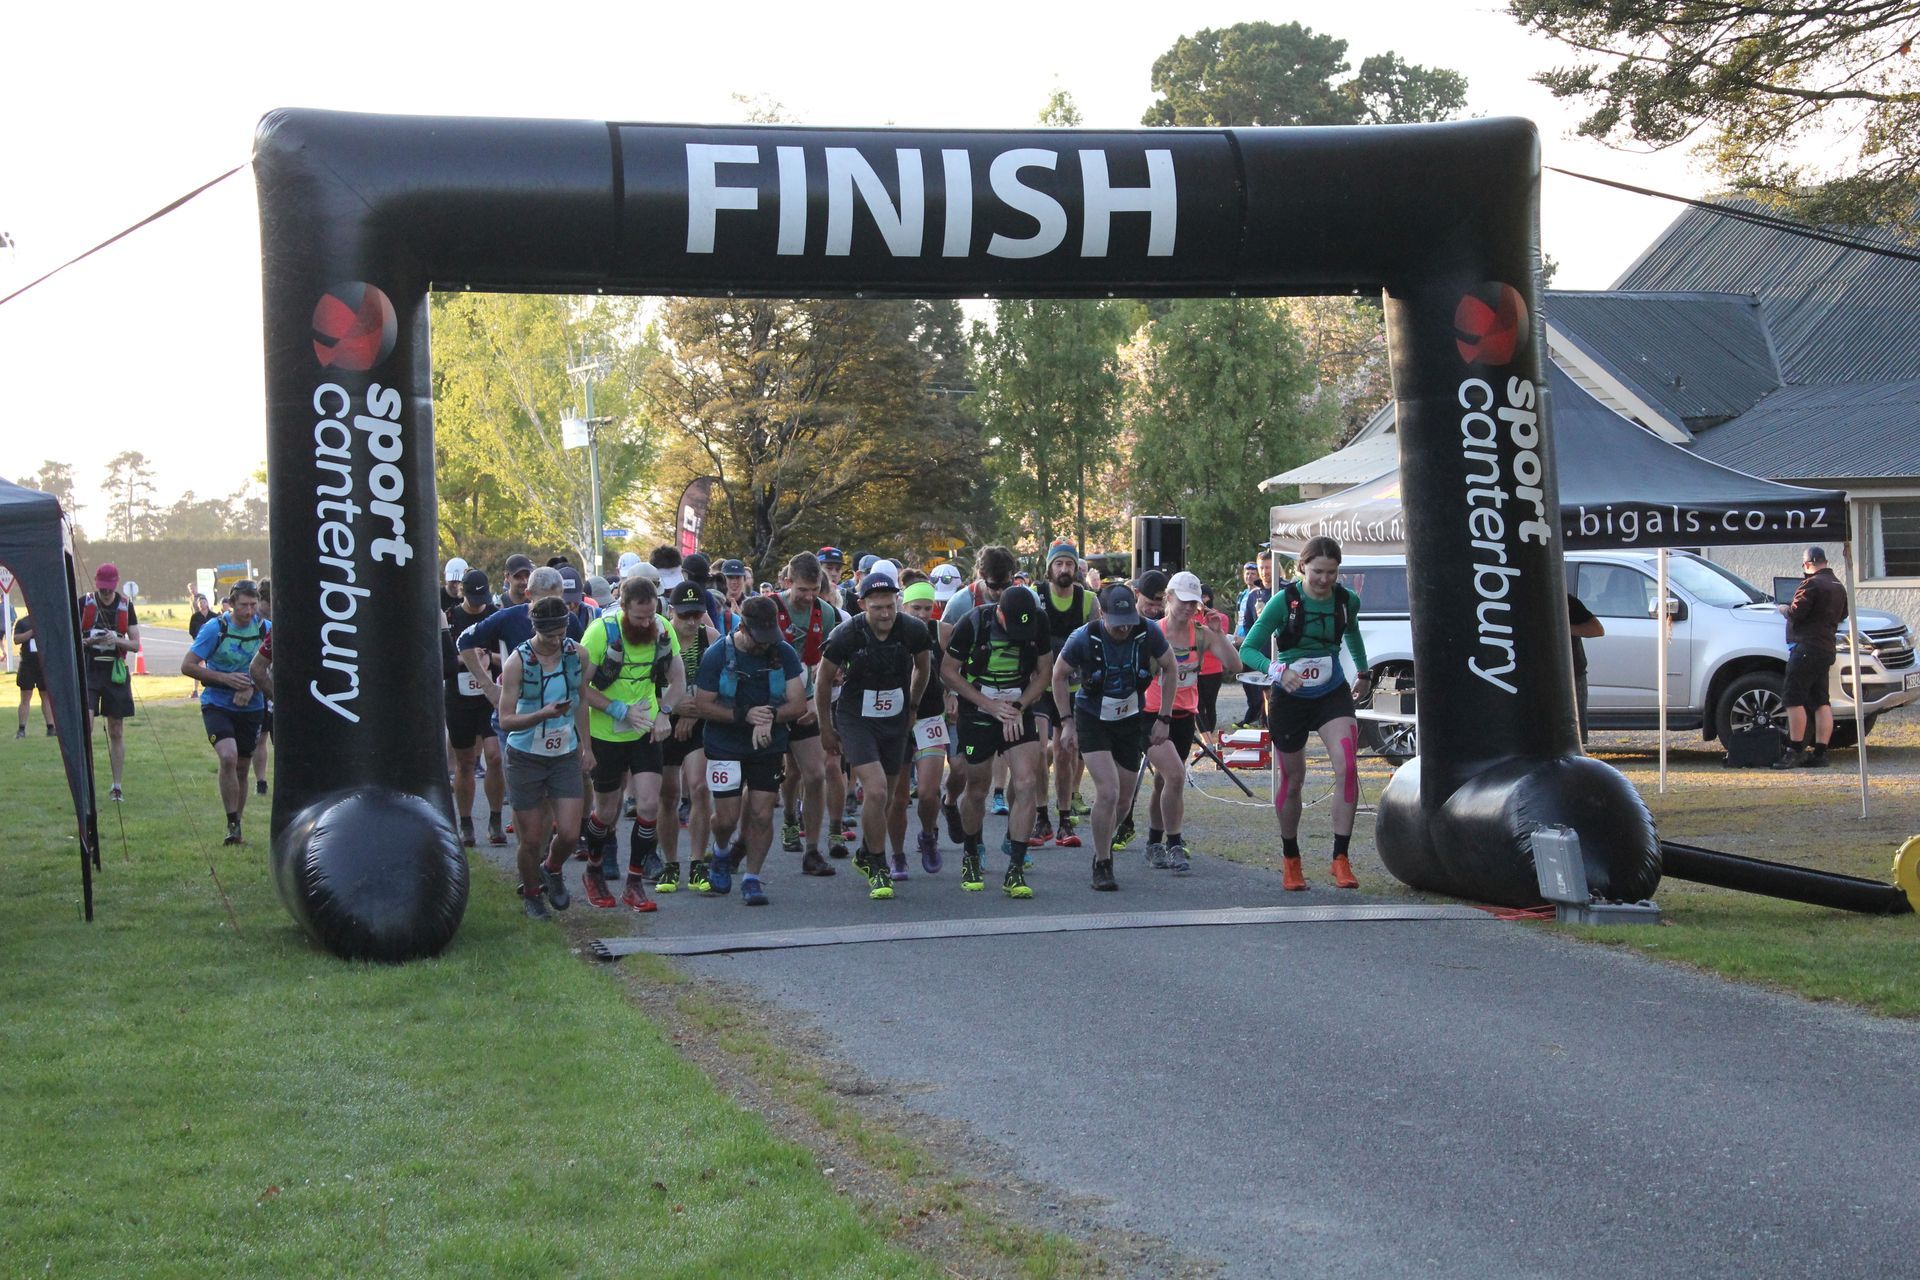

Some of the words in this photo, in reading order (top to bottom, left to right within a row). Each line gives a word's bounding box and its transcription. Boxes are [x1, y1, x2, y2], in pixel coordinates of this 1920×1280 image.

[685, 143, 1177, 259] FINISH
[354, 383, 414, 567] sport
[1498, 375, 1552, 546] sport
[310, 383, 371, 723] canterbury
[1458, 378, 1521, 694] canterbury
[875, 699, 892, 711] 55
[1300, 667, 1319, 679] 40
[545, 737, 562, 750] 63
[926, 725, 942, 739] 30
[712, 771, 729, 784] 66
